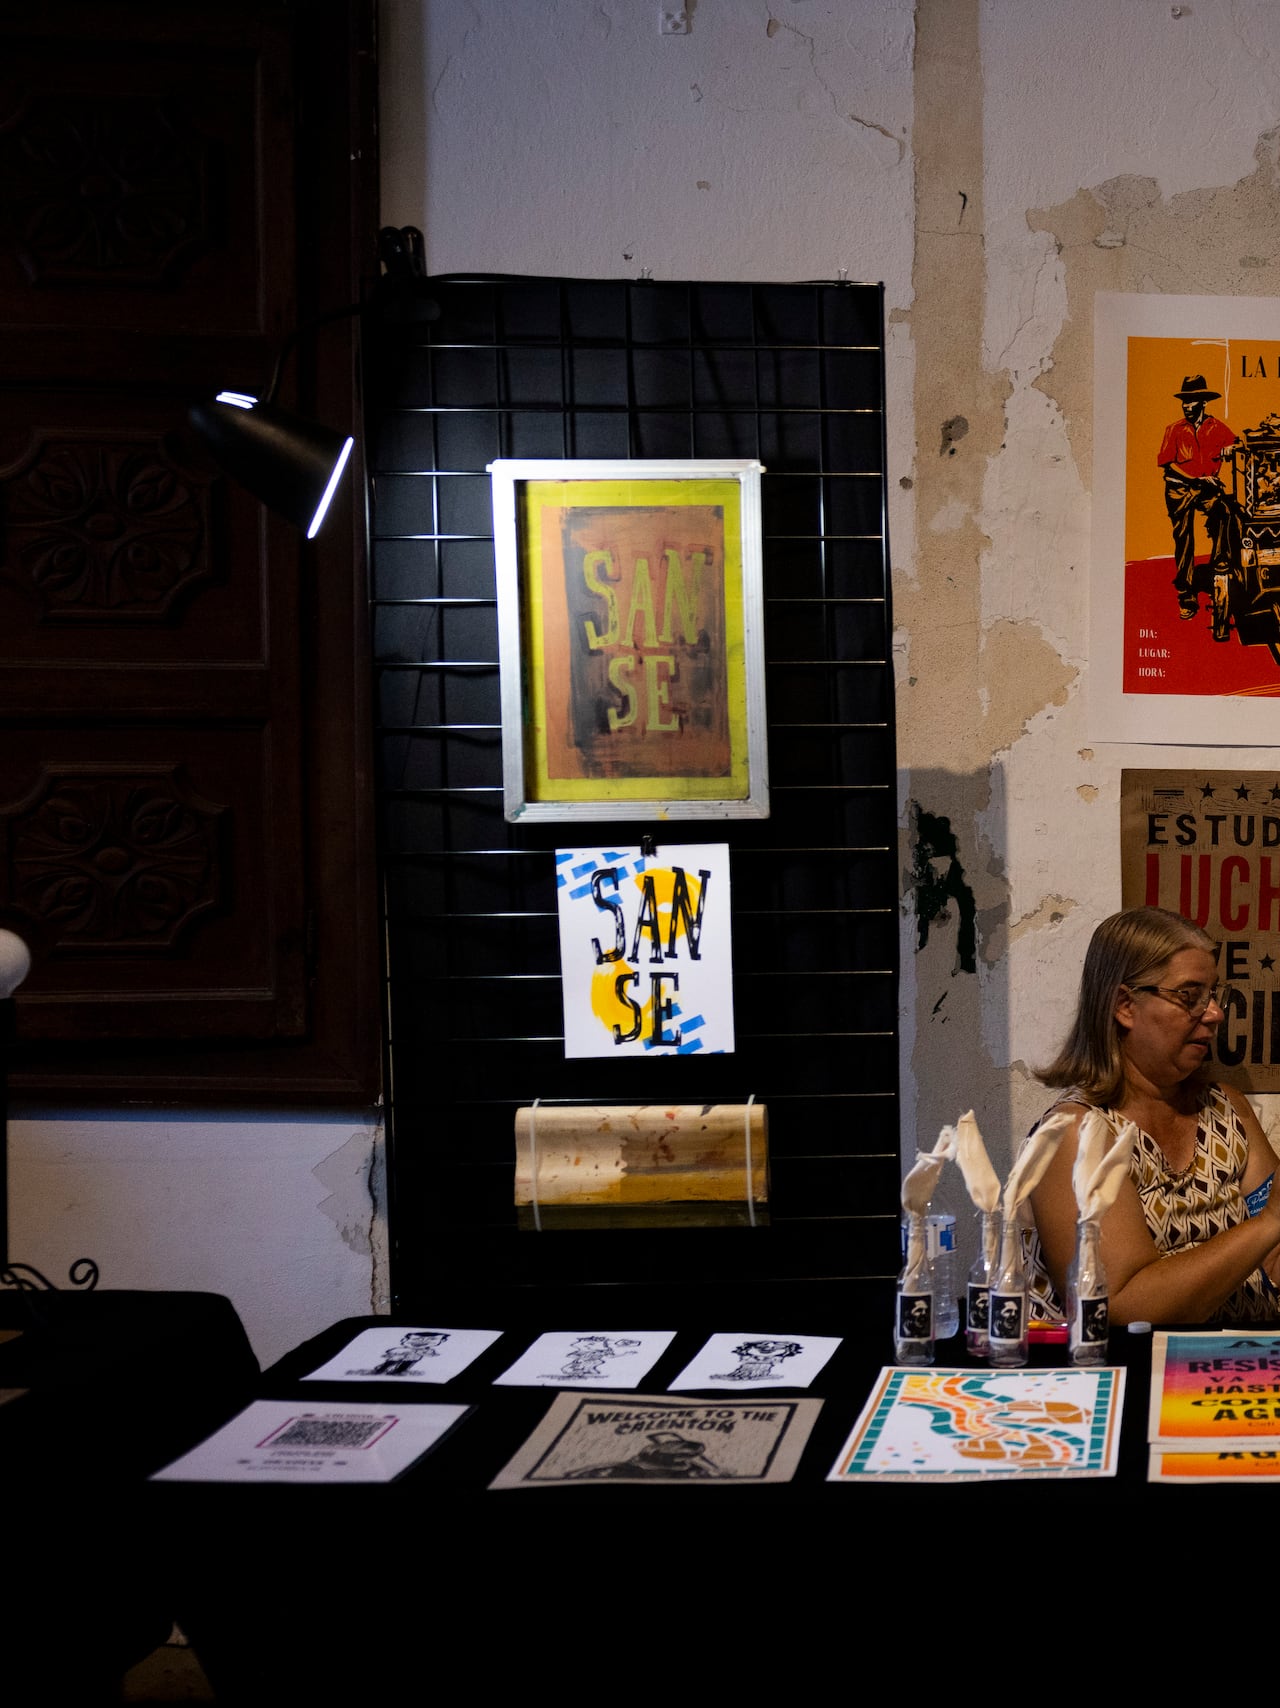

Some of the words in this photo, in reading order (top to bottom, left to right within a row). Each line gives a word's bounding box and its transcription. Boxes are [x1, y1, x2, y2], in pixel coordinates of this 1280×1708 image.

[1241, 355, 1267, 379] LA
[583, 549, 707, 650] SAN
[1138, 668, 1166, 678] HORA:
[1139, 648, 1171, 658] LUGAR:
[608, 655, 679, 731] SE
[591, 866, 711, 965] SAN
[613, 971, 682, 1046] SE
[587, 1410, 696, 1425] WELCOME
[705, 1409, 735, 1419] TO
[742, 1411, 778, 1422] THE
